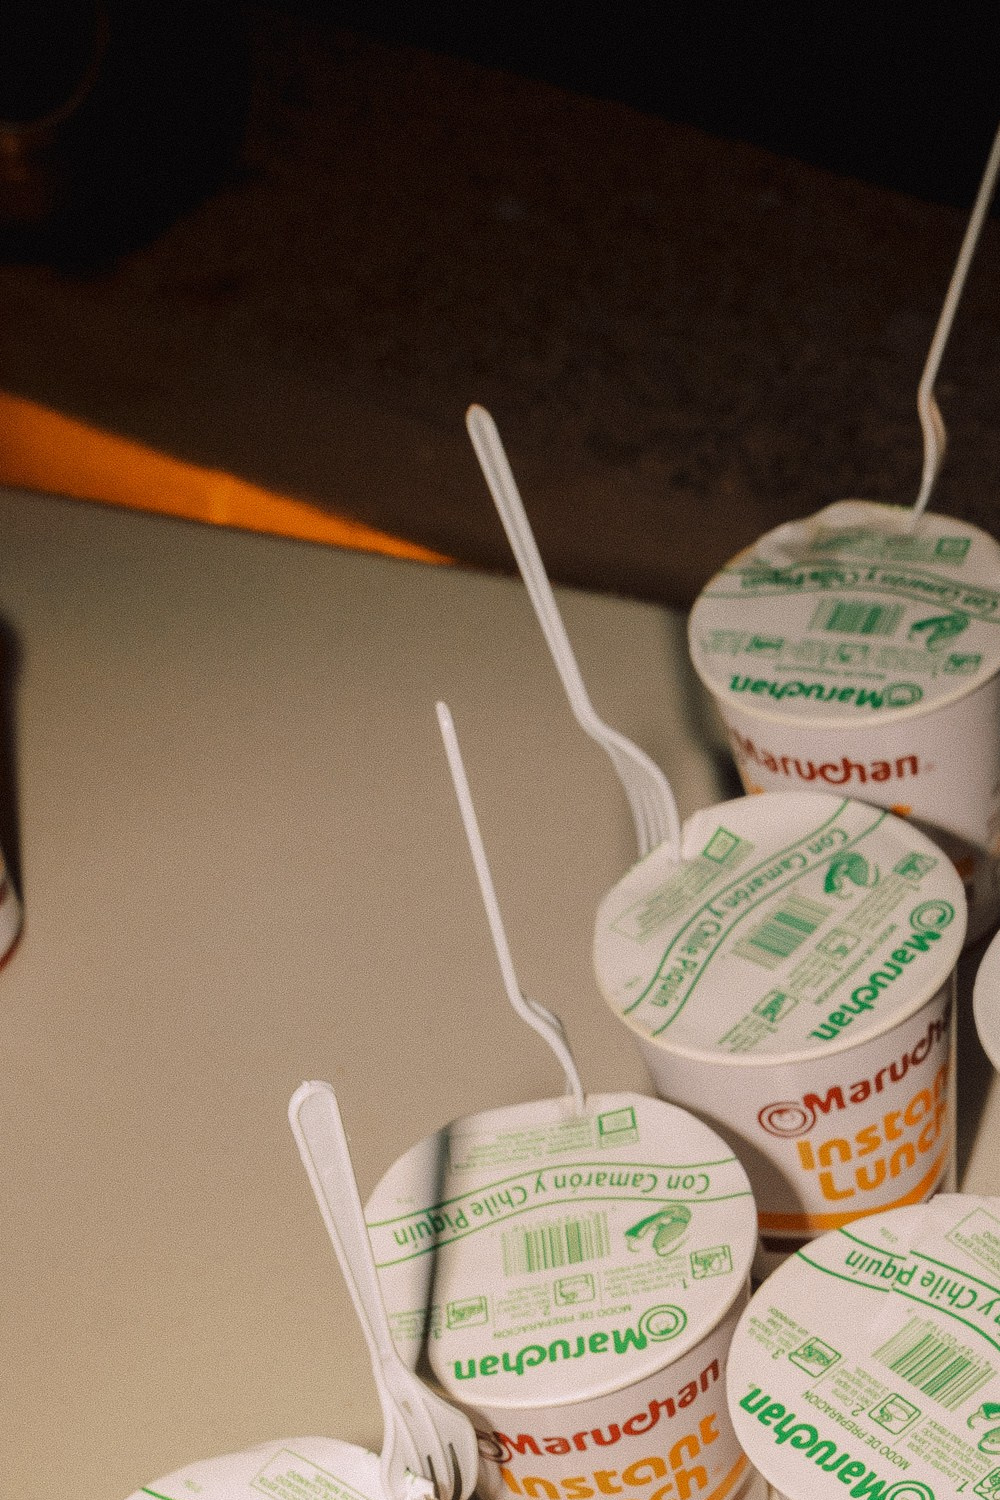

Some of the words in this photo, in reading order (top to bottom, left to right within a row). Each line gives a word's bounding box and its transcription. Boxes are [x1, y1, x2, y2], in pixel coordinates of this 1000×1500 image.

[811, 930, 942, 1042] Maruchan
[471, 1187, 528, 1217] Chile
[534, 1171, 548, 1192] y
[553, 1171, 658, 1193] Camarón
[667, 1173, 711, 1192] Con
[845, 1250, 913, 1291] Piquín
[919, 1268, 979, 1311] Chile
[454, 1325, 648, 1380] Maruchan
[495, 1358, 720, 1456] Maruchan
[501, 1412, 720, 1496] Instant
